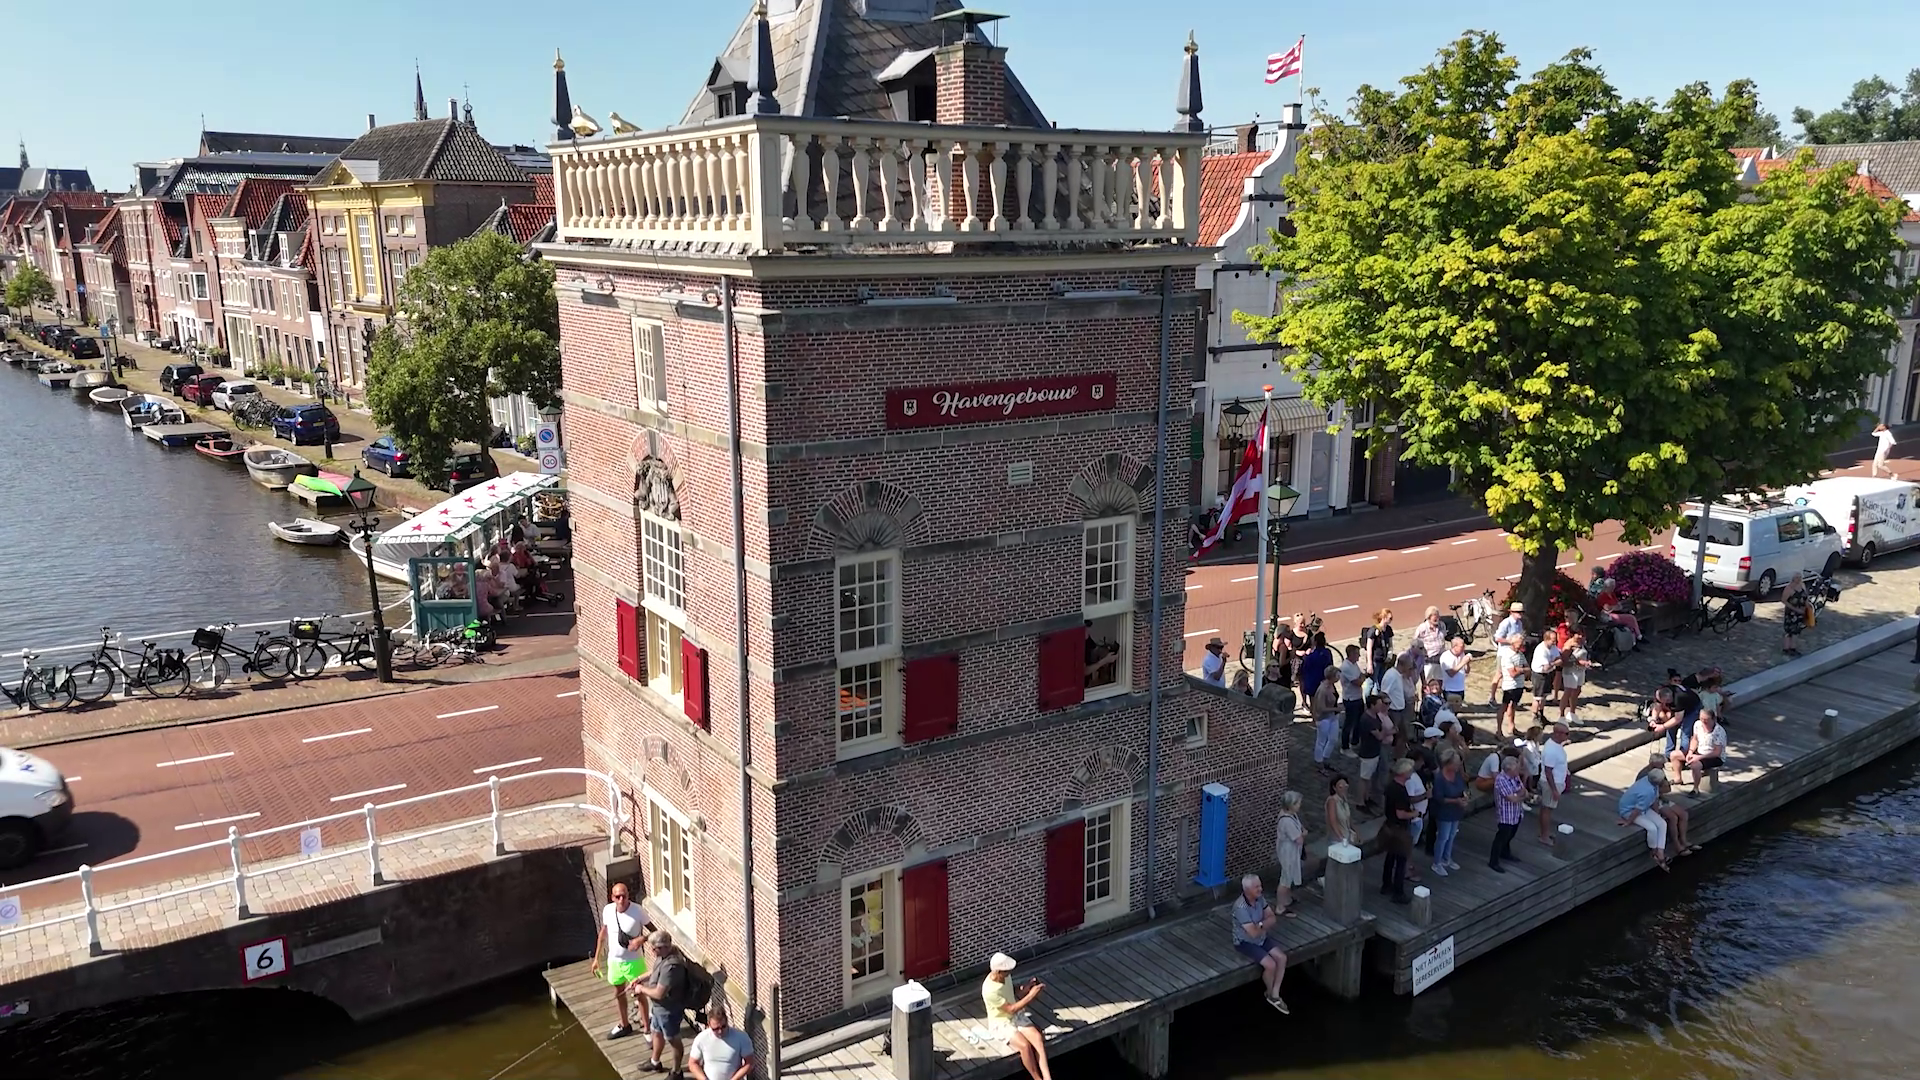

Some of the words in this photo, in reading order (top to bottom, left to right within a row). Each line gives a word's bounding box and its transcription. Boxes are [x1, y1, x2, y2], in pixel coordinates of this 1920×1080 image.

[932, 385, 1079, 417] Havengebouw
[376, 535, 446, 544] Heineken
[256, 947, 274, 969] 6
